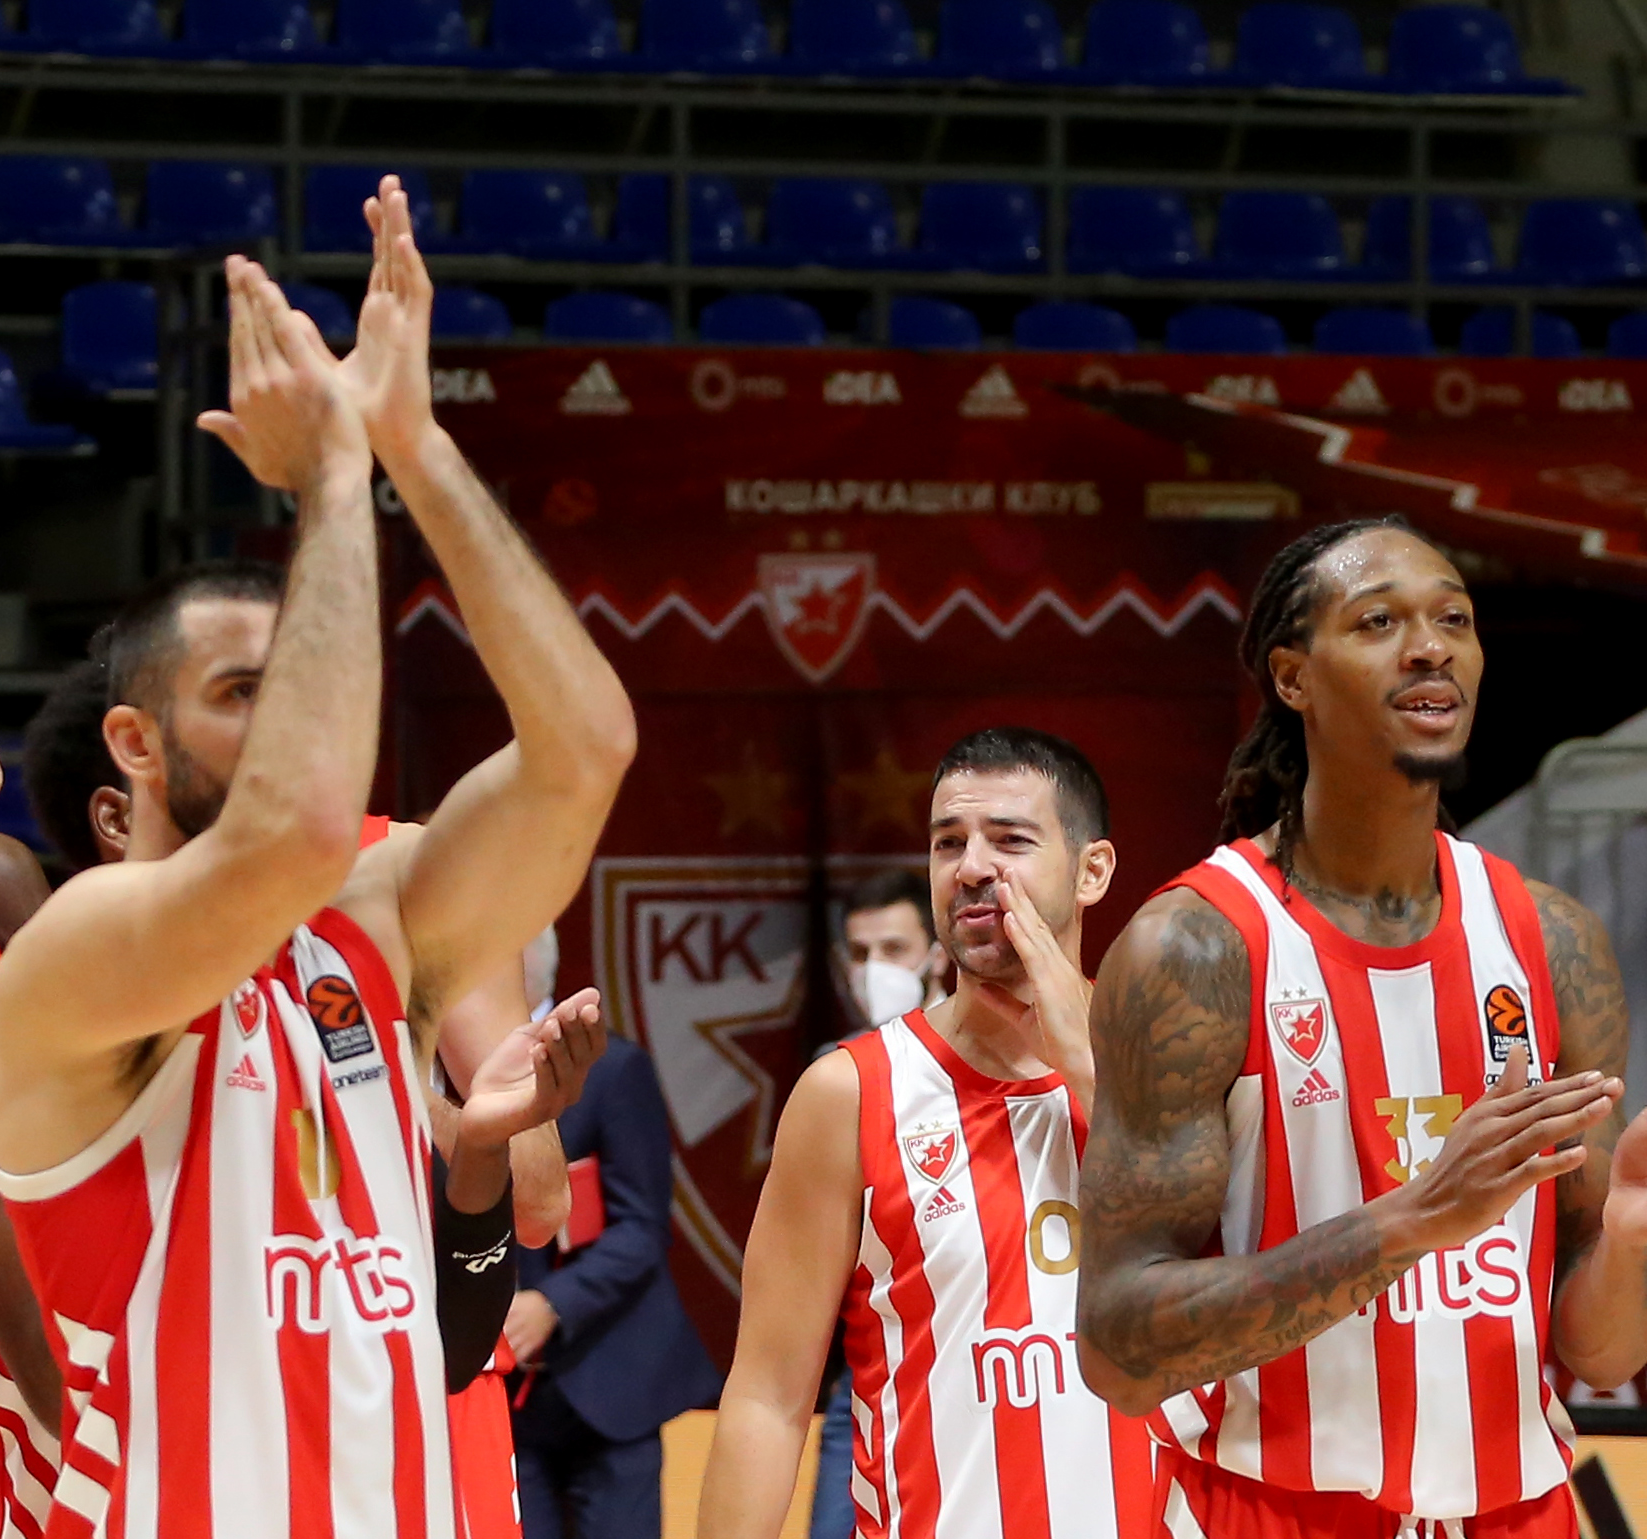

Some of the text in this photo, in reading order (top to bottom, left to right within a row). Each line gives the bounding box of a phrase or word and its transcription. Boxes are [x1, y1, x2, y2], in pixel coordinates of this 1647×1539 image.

[1005, 480, 1102, 515] КЛУБ
[649, 912, 767, 984] KK
[1276, 1008, 1294, 1019] KK
[1292, 1088, 1340, 1108] adidas
[924, 1201, 965, 1222] adidas
[264, 1236, 414, 1322] mts
